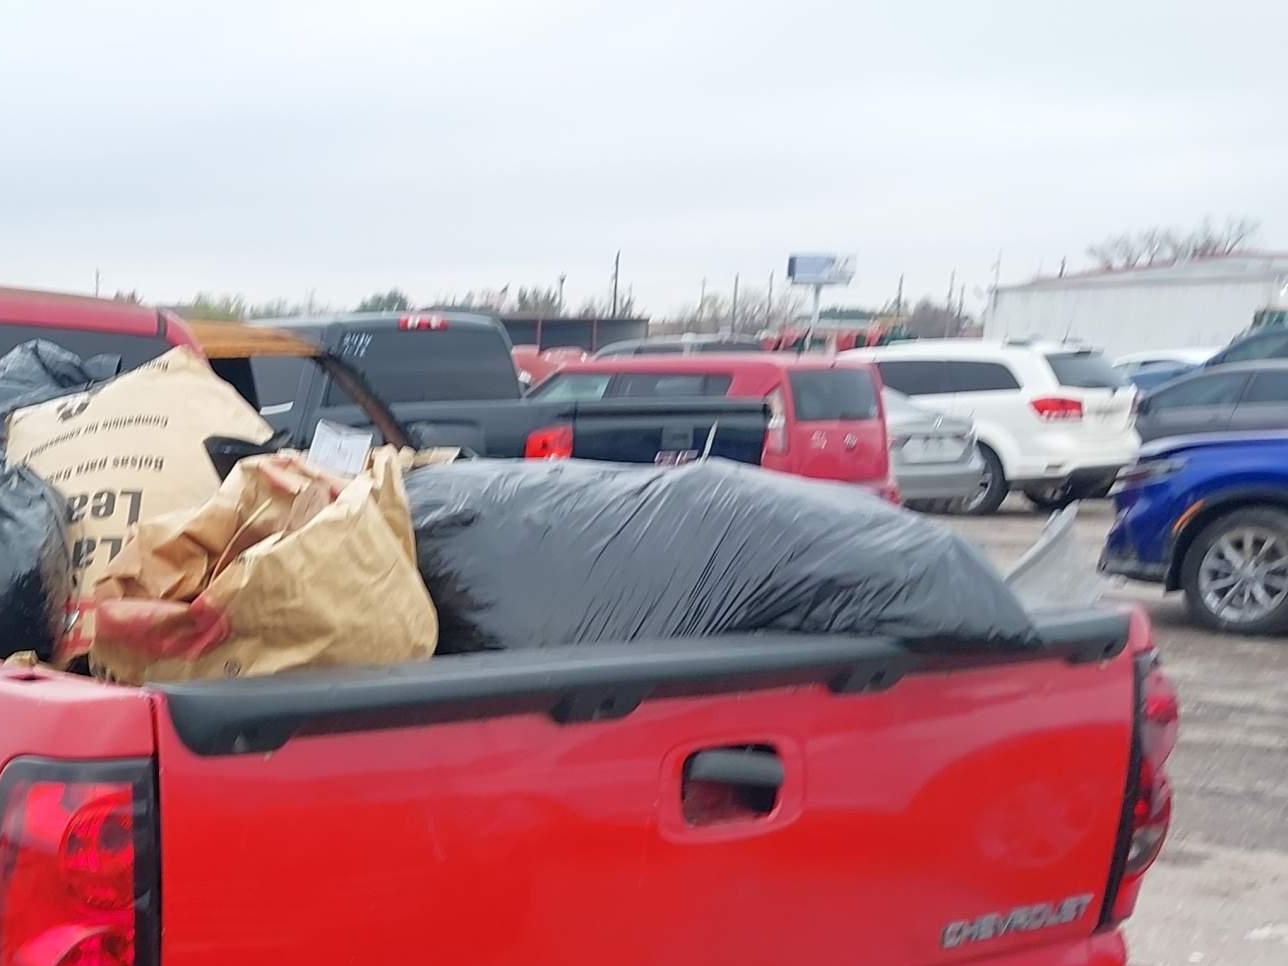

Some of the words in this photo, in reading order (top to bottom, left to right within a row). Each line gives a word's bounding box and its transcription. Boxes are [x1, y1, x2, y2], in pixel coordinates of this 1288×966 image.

[83, 421, 100, 436] for
[76, 456, 109, 475] para
[111, 455, 164, 472] Bolsas
[941, 892, 1096, 949] CHEVROLET
